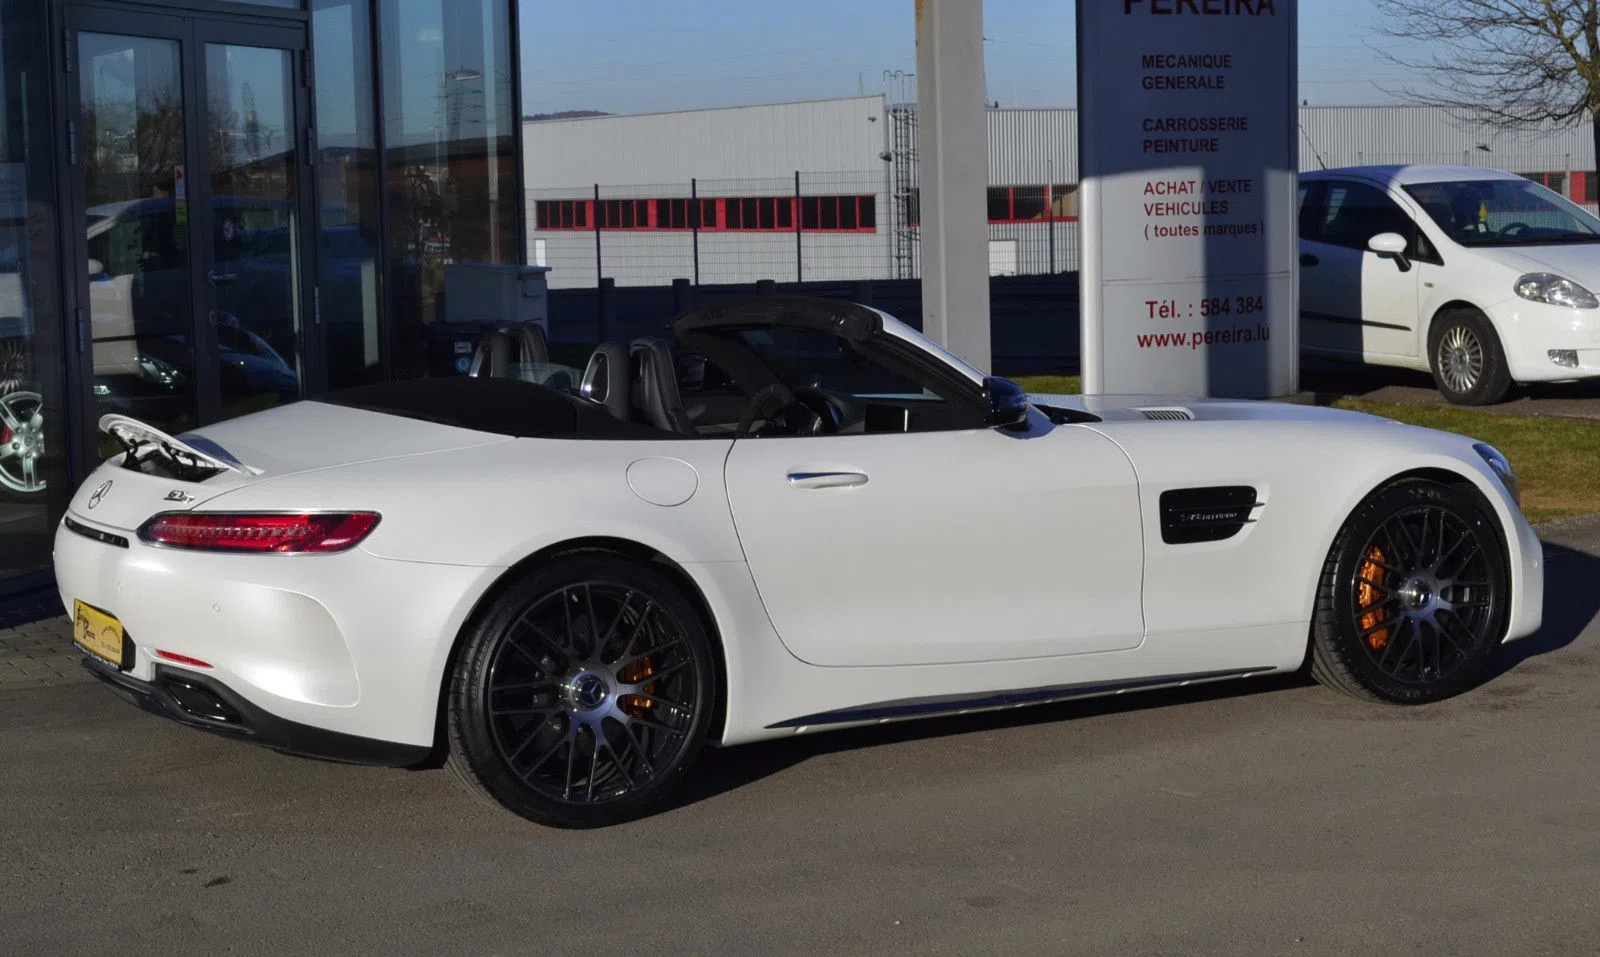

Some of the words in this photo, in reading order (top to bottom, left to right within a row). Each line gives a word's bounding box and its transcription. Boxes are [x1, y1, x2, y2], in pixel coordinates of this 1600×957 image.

[1141, 54, 1233, 69] MECANIQUE
[1142, 75, 1225, 90] GENERALE
[1142, 117, 1248, 132] CARROSSERIE
[1143, 138, 1219, 153] PEINTURE
[1143, 180, 1196, 195] ACHAT
[1208, 179, 1252, 193] VENTE
[1143, 201, 1228, 216] VEHICULES
[1154, 223, 1199, 237] toutes
[1204, 222, 1257, 236] marques
[1145, 300, 1181, 318] Tél.
[1200, 299, 1231, 317] 584
[1235, 296, 1264, 314] 384
[1137, 324, 1270, 350] www.pereira.lu
